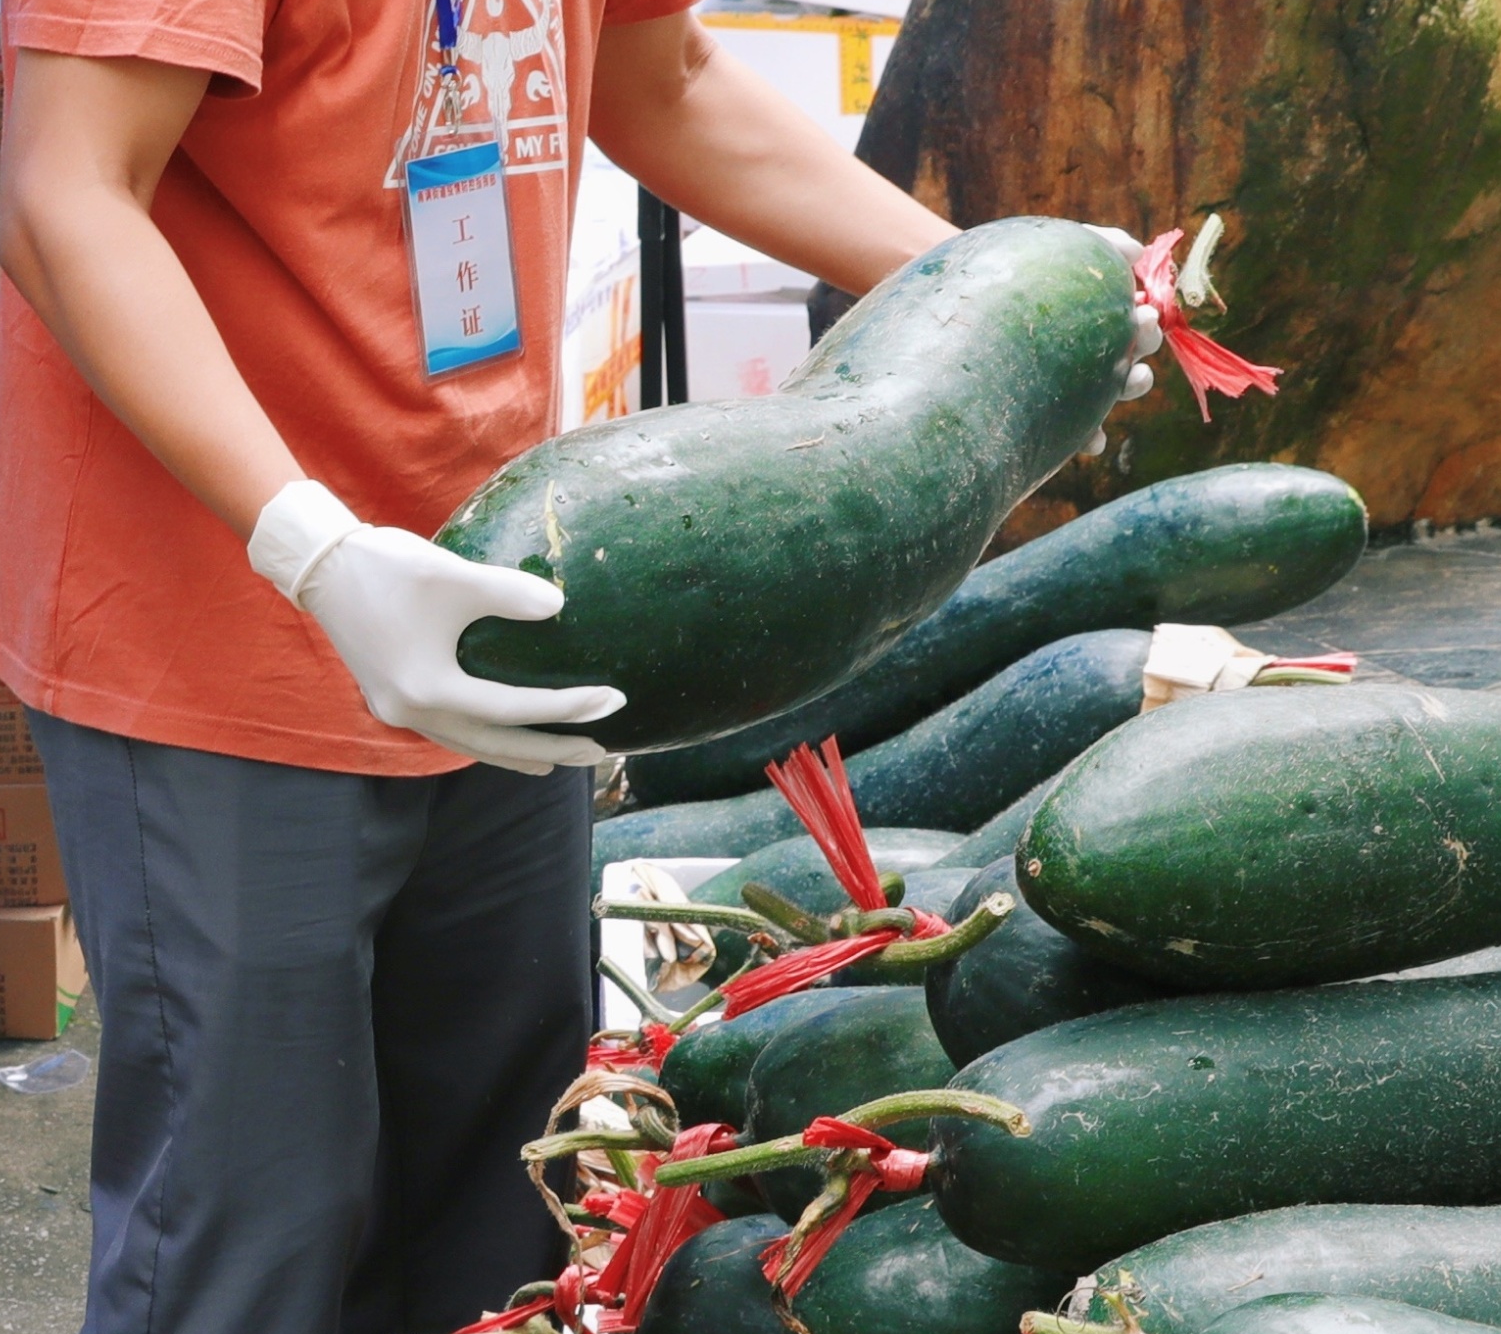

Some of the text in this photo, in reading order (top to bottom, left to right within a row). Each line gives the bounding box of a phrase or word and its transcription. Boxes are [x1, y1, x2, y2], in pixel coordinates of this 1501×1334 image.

[515, 134, 545, 159] MY
[452, 215, 484, 338] 工作证
